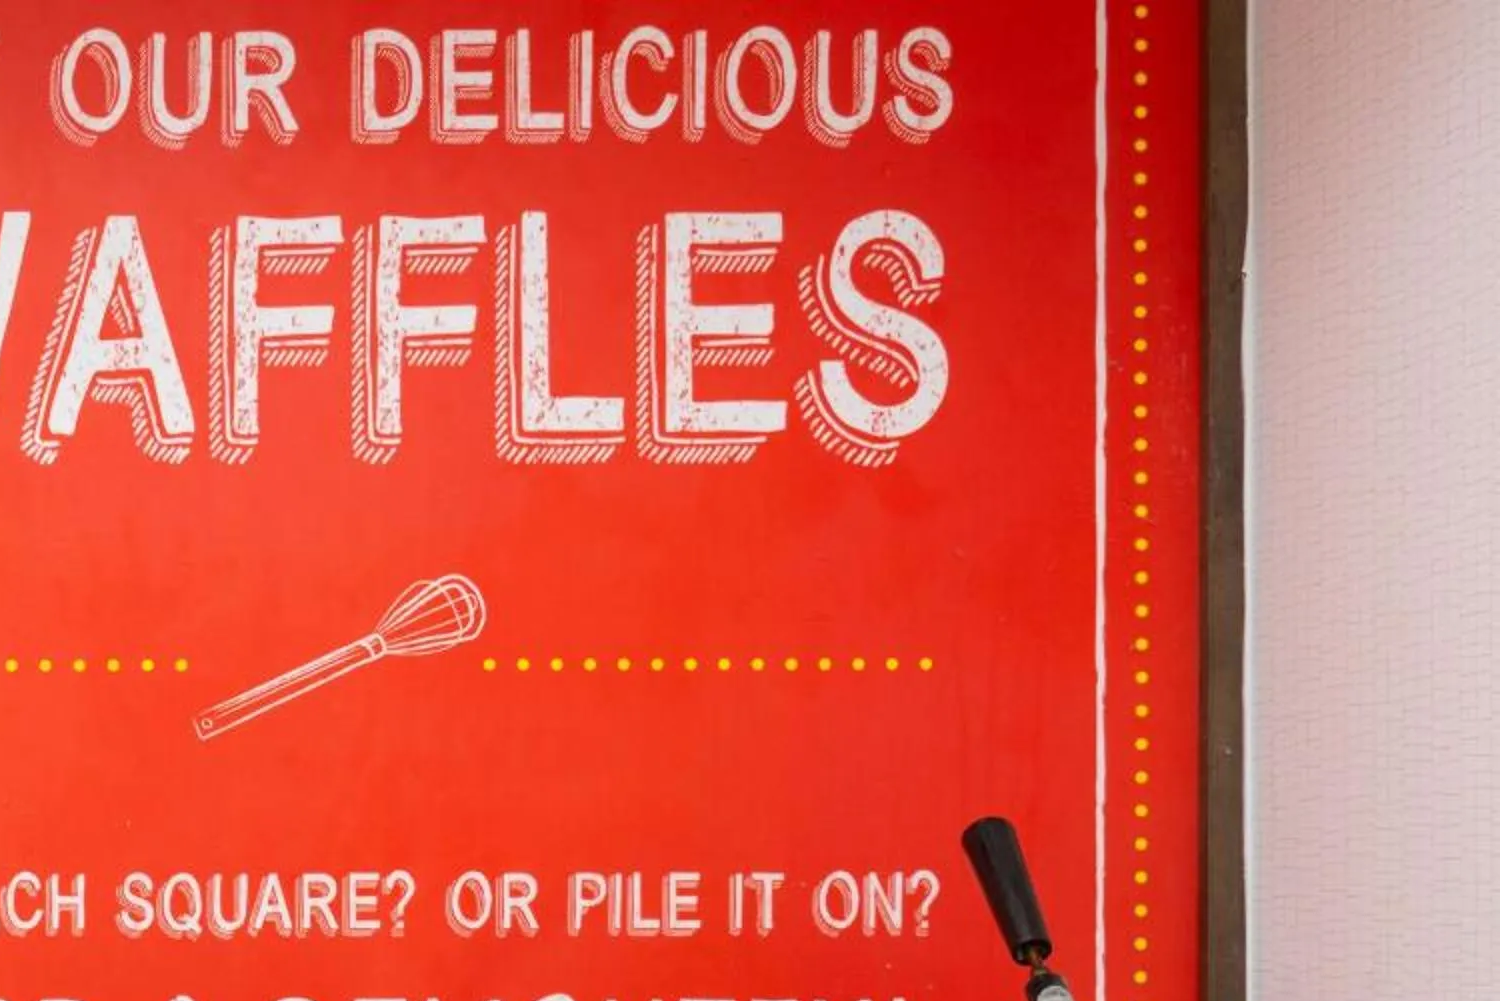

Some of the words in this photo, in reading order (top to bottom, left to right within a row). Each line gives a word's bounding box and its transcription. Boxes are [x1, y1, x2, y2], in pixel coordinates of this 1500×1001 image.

[50, 28, 299, 150] OUR
[352, 26, 952, 146] DELICIOUS
[116, 870, 416, 940] SQUARE?
[446, 871, 539, 936] OR
[568, 872, 701, 936] PILE
[730, 872, 784, 936] IT
[813, 870, 940, 936] ON?
